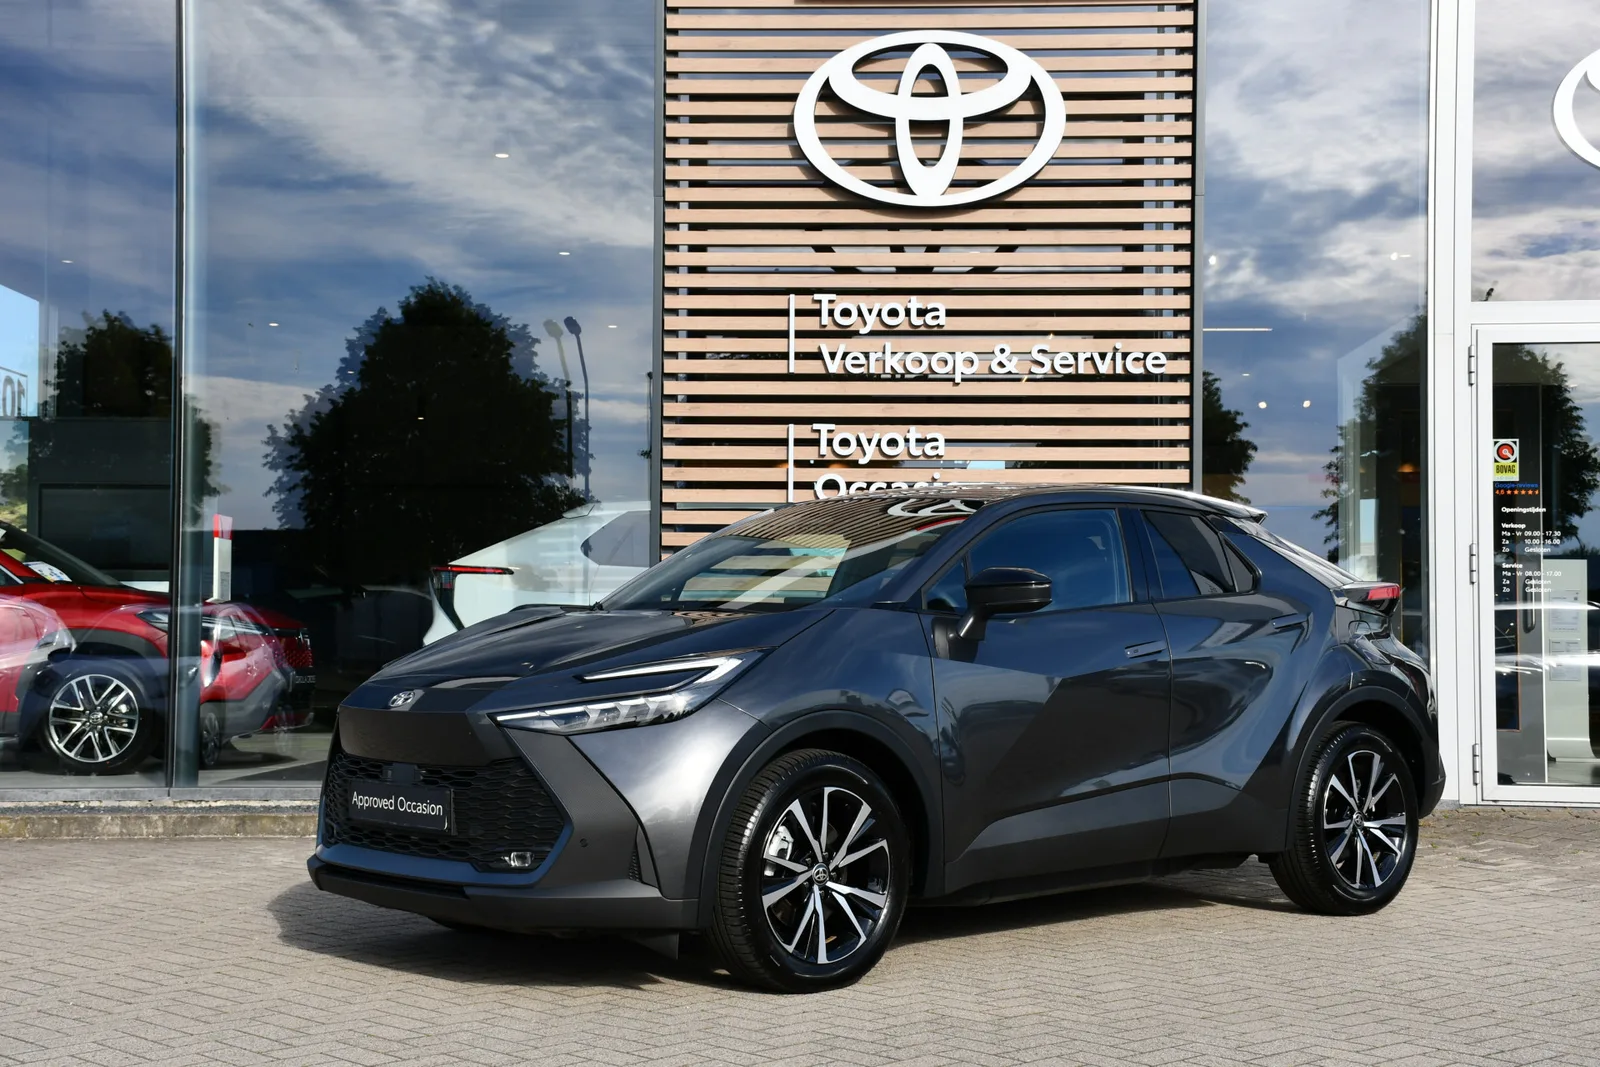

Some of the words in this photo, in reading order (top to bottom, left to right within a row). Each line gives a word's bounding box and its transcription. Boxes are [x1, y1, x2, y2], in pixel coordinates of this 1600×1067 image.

[813, 294, 946, 333] Toyota
[819, 342, 979, 382] Verkoop
[990, 344, 1018, 374] &
[1030, 343, 1167, 374] Service
[812, 424, 945, 463] Toyota
[1496, 465, 1515, 473] BOVAG
[352, 791, 395, 811] Approved
[397, 796, 443, 816] Occasion
